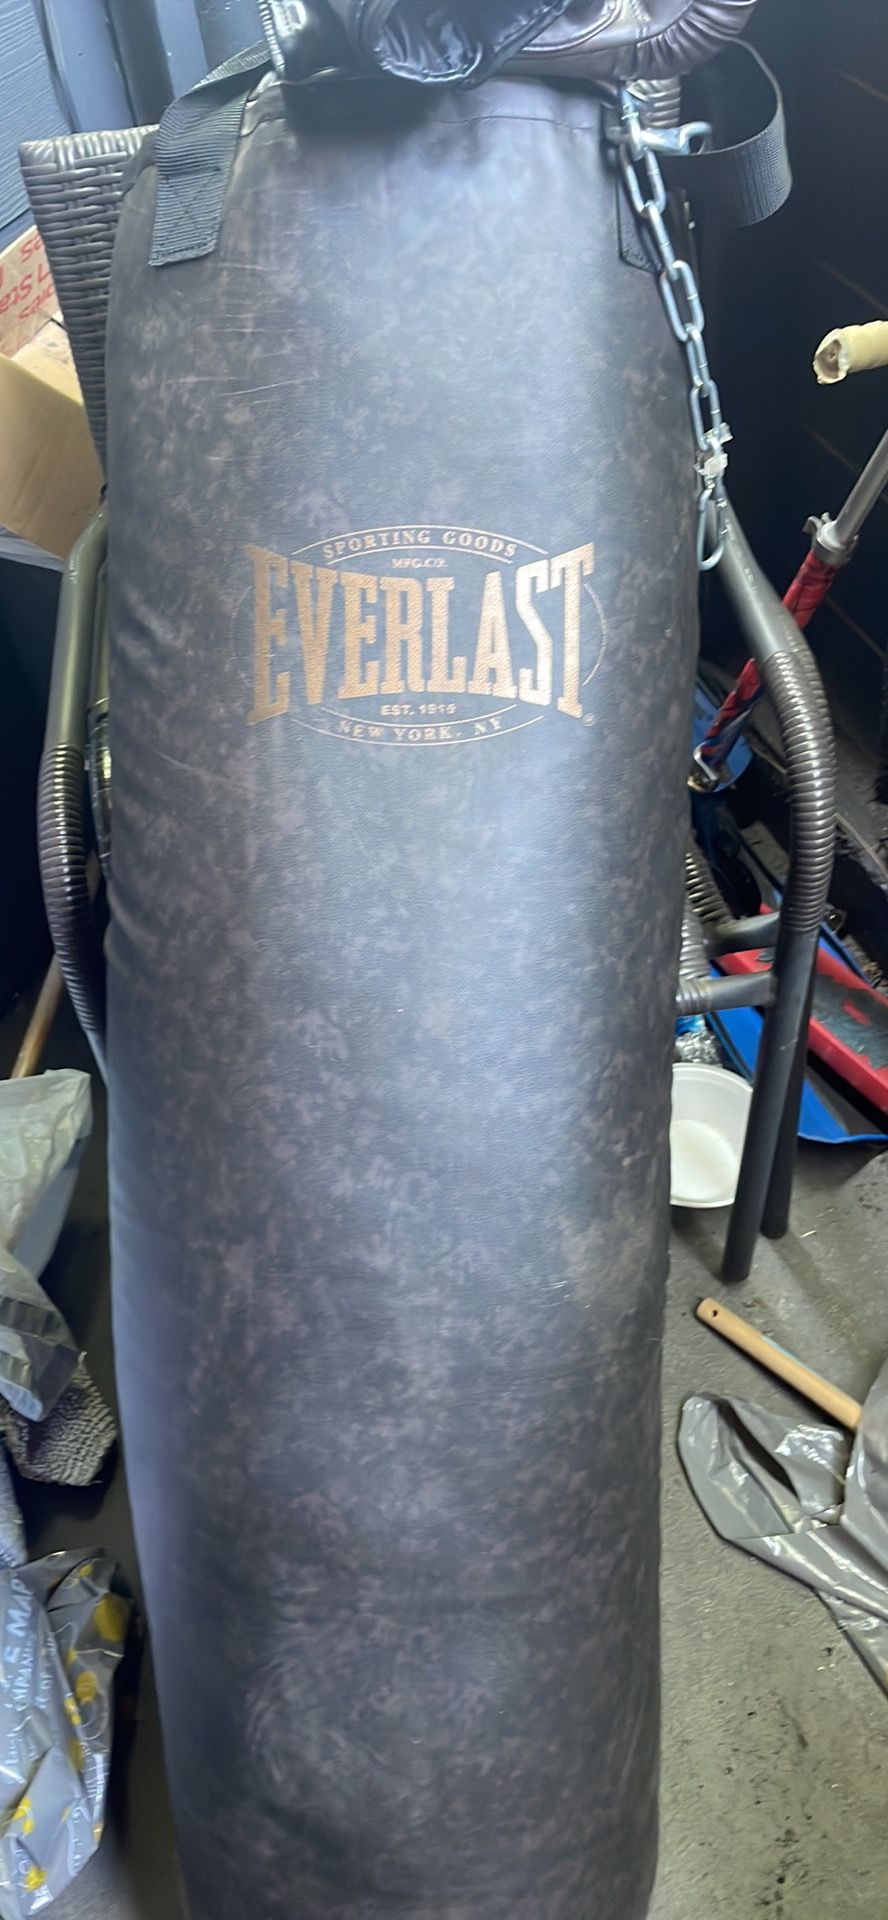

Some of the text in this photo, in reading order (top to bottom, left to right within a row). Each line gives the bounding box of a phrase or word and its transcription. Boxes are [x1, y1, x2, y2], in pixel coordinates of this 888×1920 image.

[322, 529, 518, 560] SPORTING GOODS
[245, 542, 595, 726] EVERLAST
[380, 703, 415, 716] EST.
[338, 720, 384, 738] NEW
[474, 716, 502, 736] NY
